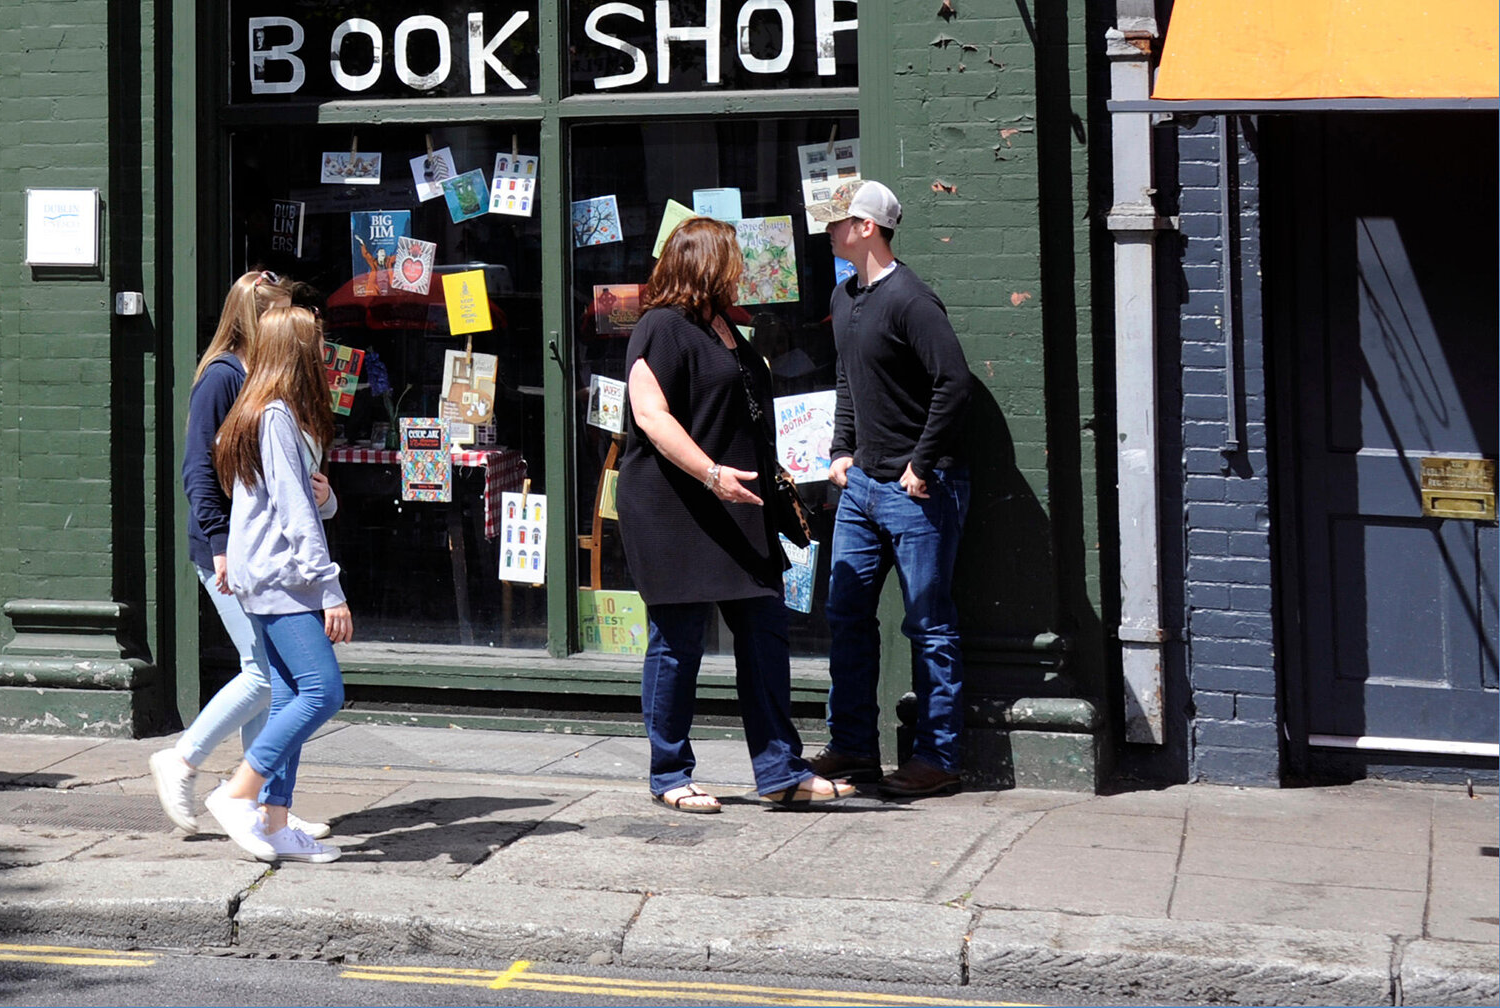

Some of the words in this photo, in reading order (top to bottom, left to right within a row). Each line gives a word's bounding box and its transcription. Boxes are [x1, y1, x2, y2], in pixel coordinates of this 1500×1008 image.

[248, 10, 530, 95] BOOK
[274, 203, 297, 220] DUB
[700, 205, 713, 215] 54
[273, 217, 295, 234] LIN
[371, 214, 393, 226] BIG
[369, 225, 396, 241] JIM
[272, 235, 293, 252] ERS
[596, 615, 626, 626] BEST
[585, 624, 627, 645] GAMES
